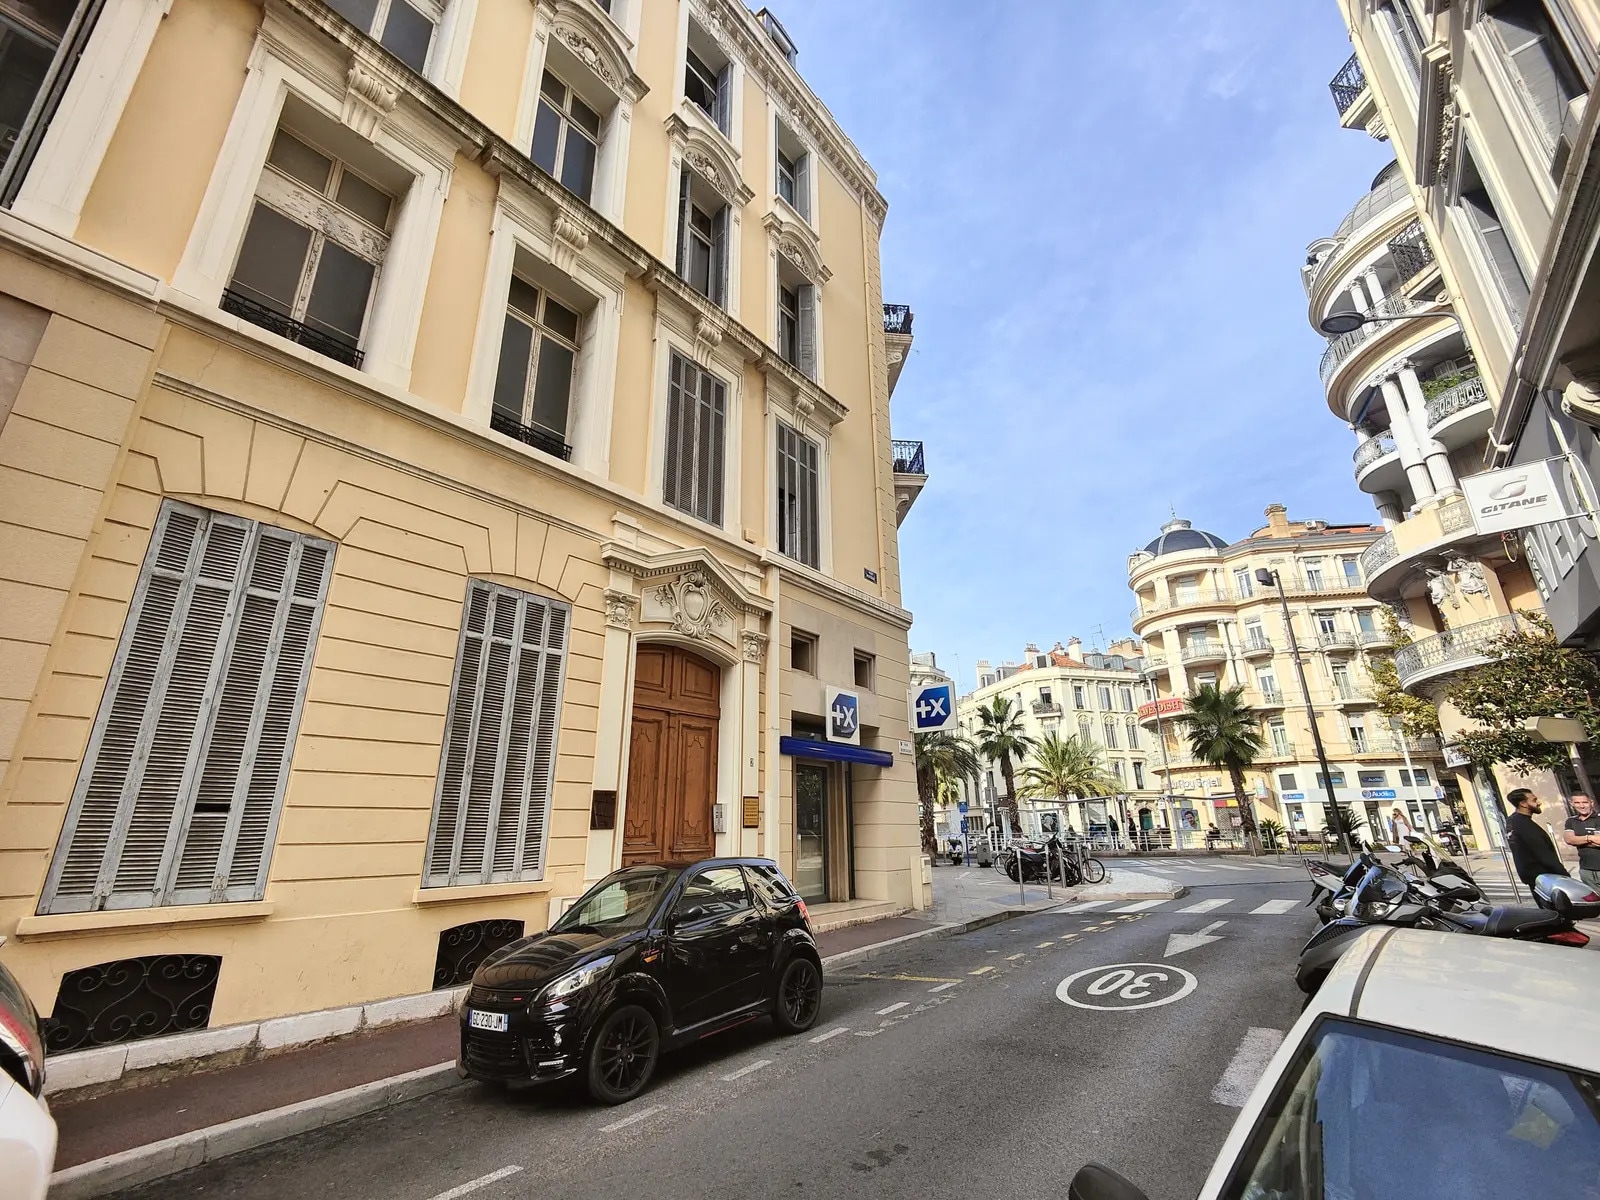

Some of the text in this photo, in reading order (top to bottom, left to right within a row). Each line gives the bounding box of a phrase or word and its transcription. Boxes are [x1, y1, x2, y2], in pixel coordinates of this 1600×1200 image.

[1481, 494, 1548, 514] GITANE
[1371, 789, 1395, 798] Audika
[1087, 969, 1169, 999] 30
